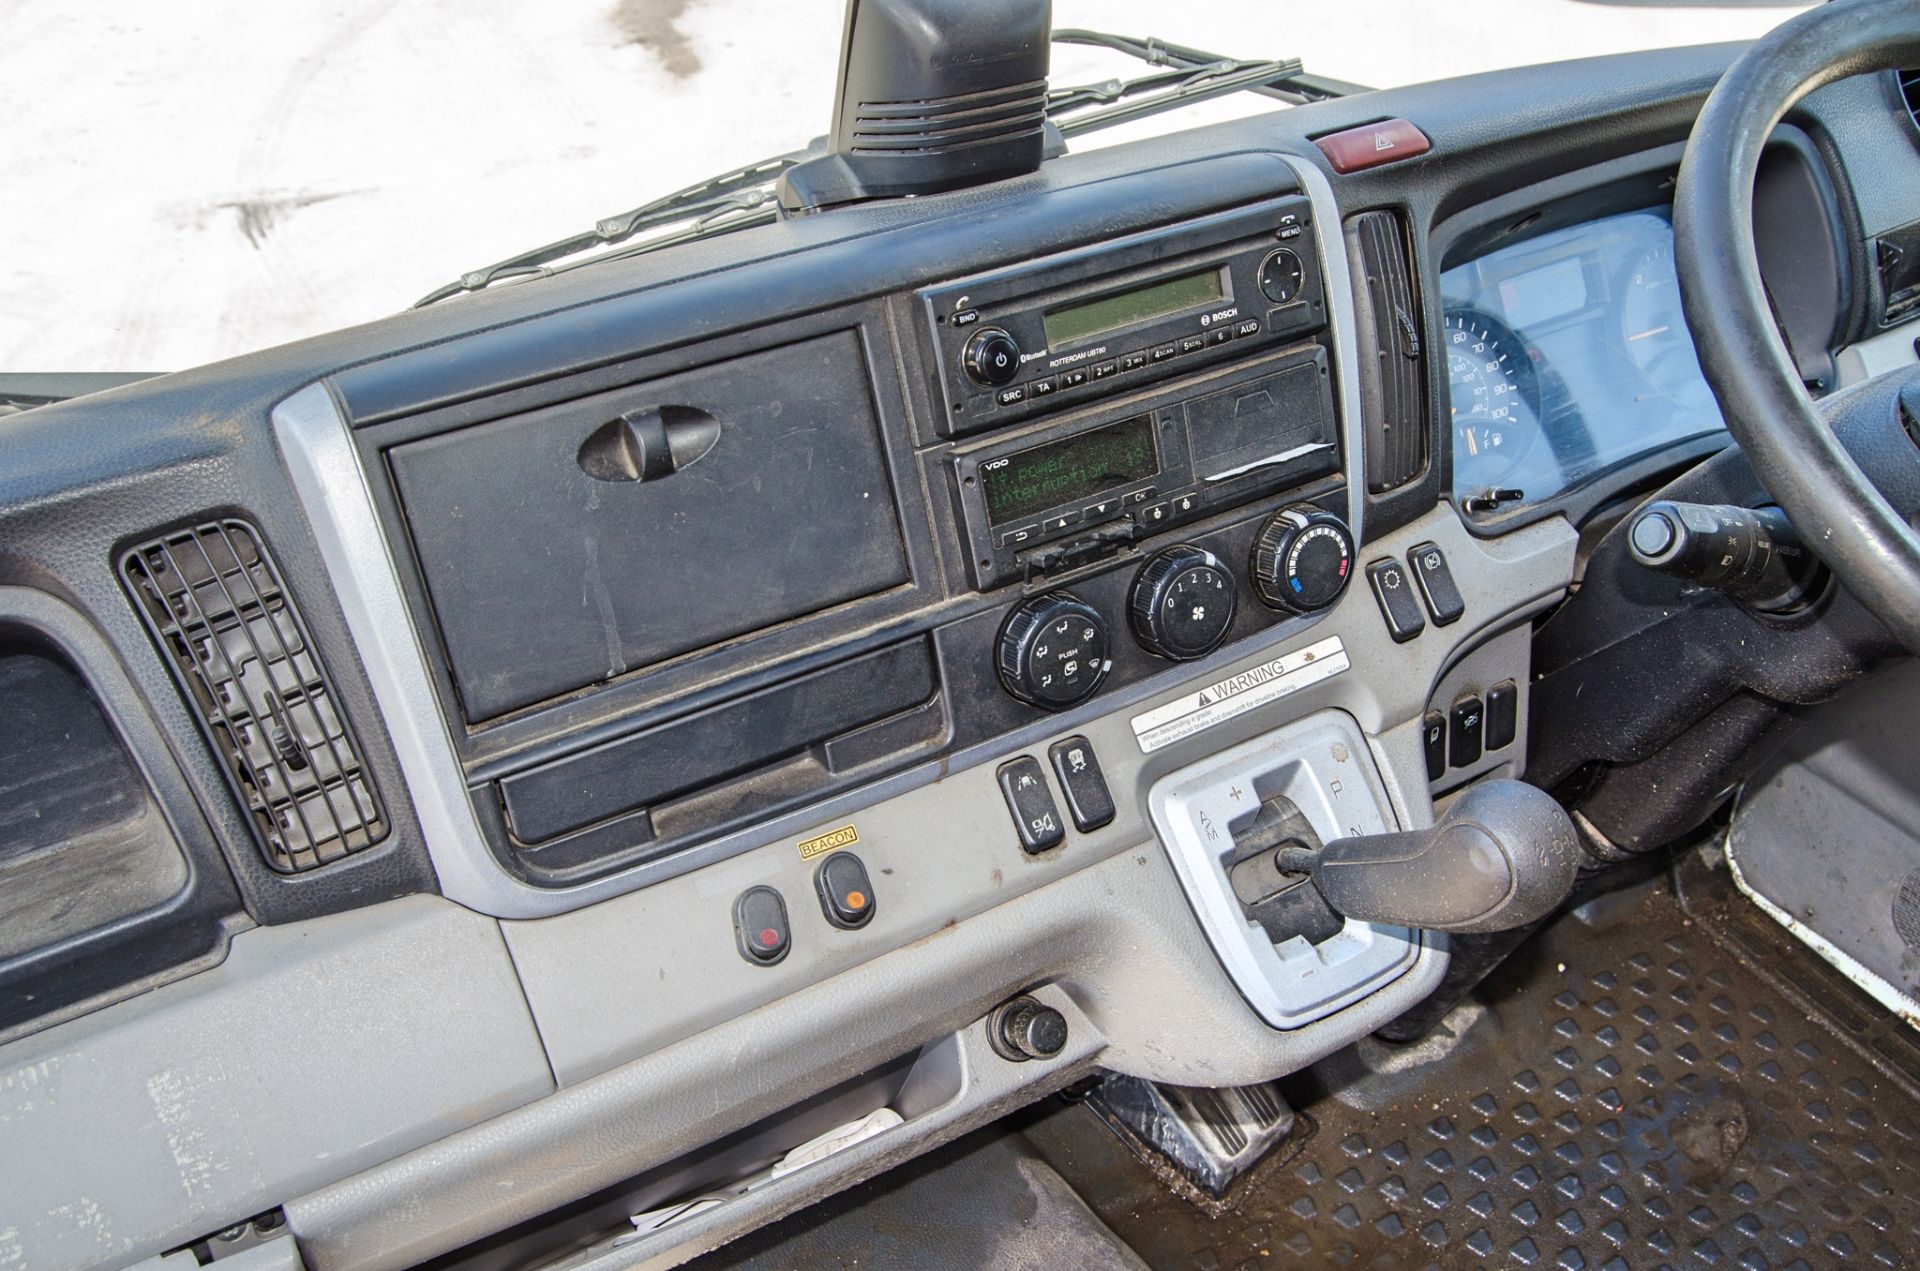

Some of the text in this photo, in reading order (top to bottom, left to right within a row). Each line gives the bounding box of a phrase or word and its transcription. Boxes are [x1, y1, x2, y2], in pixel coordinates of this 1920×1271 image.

[1281, 227, 1299, 238] MENU
[959, 313, 976, 324] BND
[1212, 308, 1238, 322] BOSCH
[1241, 322, 1258, 334] AUD
[1218, 332, 1224, 340] 6
[1453, 331, 1467, 344] 60
[1472, 342, 1485, 354] 70
[1050, 352, 1087, 368] ROTTERDAM
[1126, 358, 1132, 367] 3
[1486, 360, 1499, 372] 80
[1096, 367, 1102, 376] 2
[1038, 383, 1050, 393] TA
[1494, 383, 1507, 395] 90
[1003, 390, 1022, 402] SRC
[1491, 406, 1509, 419] 100
[1483, 440, 1490, 450] F
[985, 459, 1009, 471] VDO
[1135, 491, 1147, 502] OK
[1191, 573, 1198, 584] 2
[1205, 573, 1212, 583] 3
[1178, 582, 1183, 592] 1
[1216, 579, 1223, 590] 4
[1167, 597, 1174, 608] 0
[1058, 648, 1078, 660] PUSH
[1213, 660, 1285, 699] WARNING
[1141, 731, 1159, 743] When
[1330, 780, 1343, 800] P
[1350, 824, 1366, 838] N
[802, 829, 854, 855] BEACON
